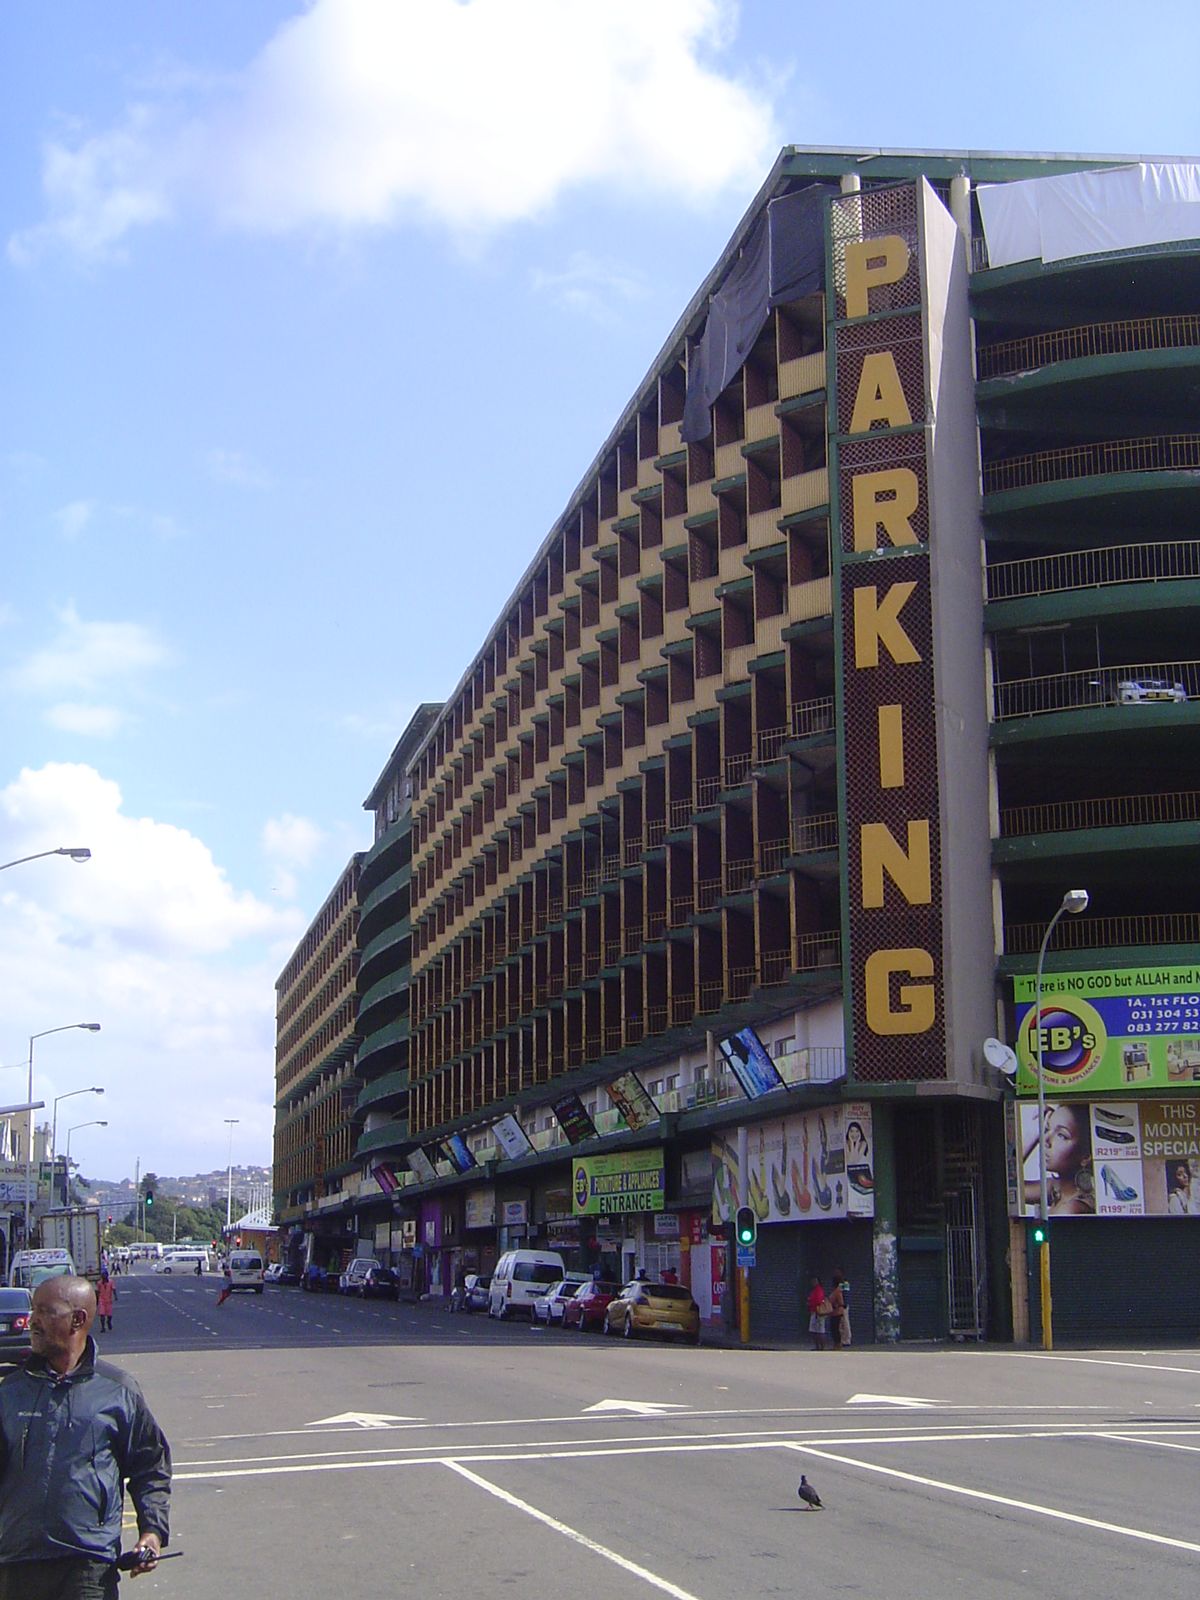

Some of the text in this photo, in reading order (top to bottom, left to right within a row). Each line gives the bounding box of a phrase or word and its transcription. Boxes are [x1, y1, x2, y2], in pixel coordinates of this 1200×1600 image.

[845, 234, 935, 1036] PARKING
[1057, 978, 1065, 991] is
[1067, 977, 1085, 990] NO
[1087, 975, 1111, 989] GOD
[1114, 973, 1132, 987] but
[1135, 972, 1170, 986] ALLAH
[1173, 970, 1192, 984] and
[1150, 997, 1170, 1006] 1st
[1131, 1010, 1153, 1019] 031
[1156, 1009, 1180, 1018] 304
[1127, 1023, 1151, 1033] 083
[1155, 1022, 1179, 1031] 277
[1028, 1025, 1097, 1053] EB's
[1160, 1104, 1196, 1119] THIS
[1143, 1141, 1200, 1156] SPECIA
[600, 1193, 652, 1213] ENTRANCE
